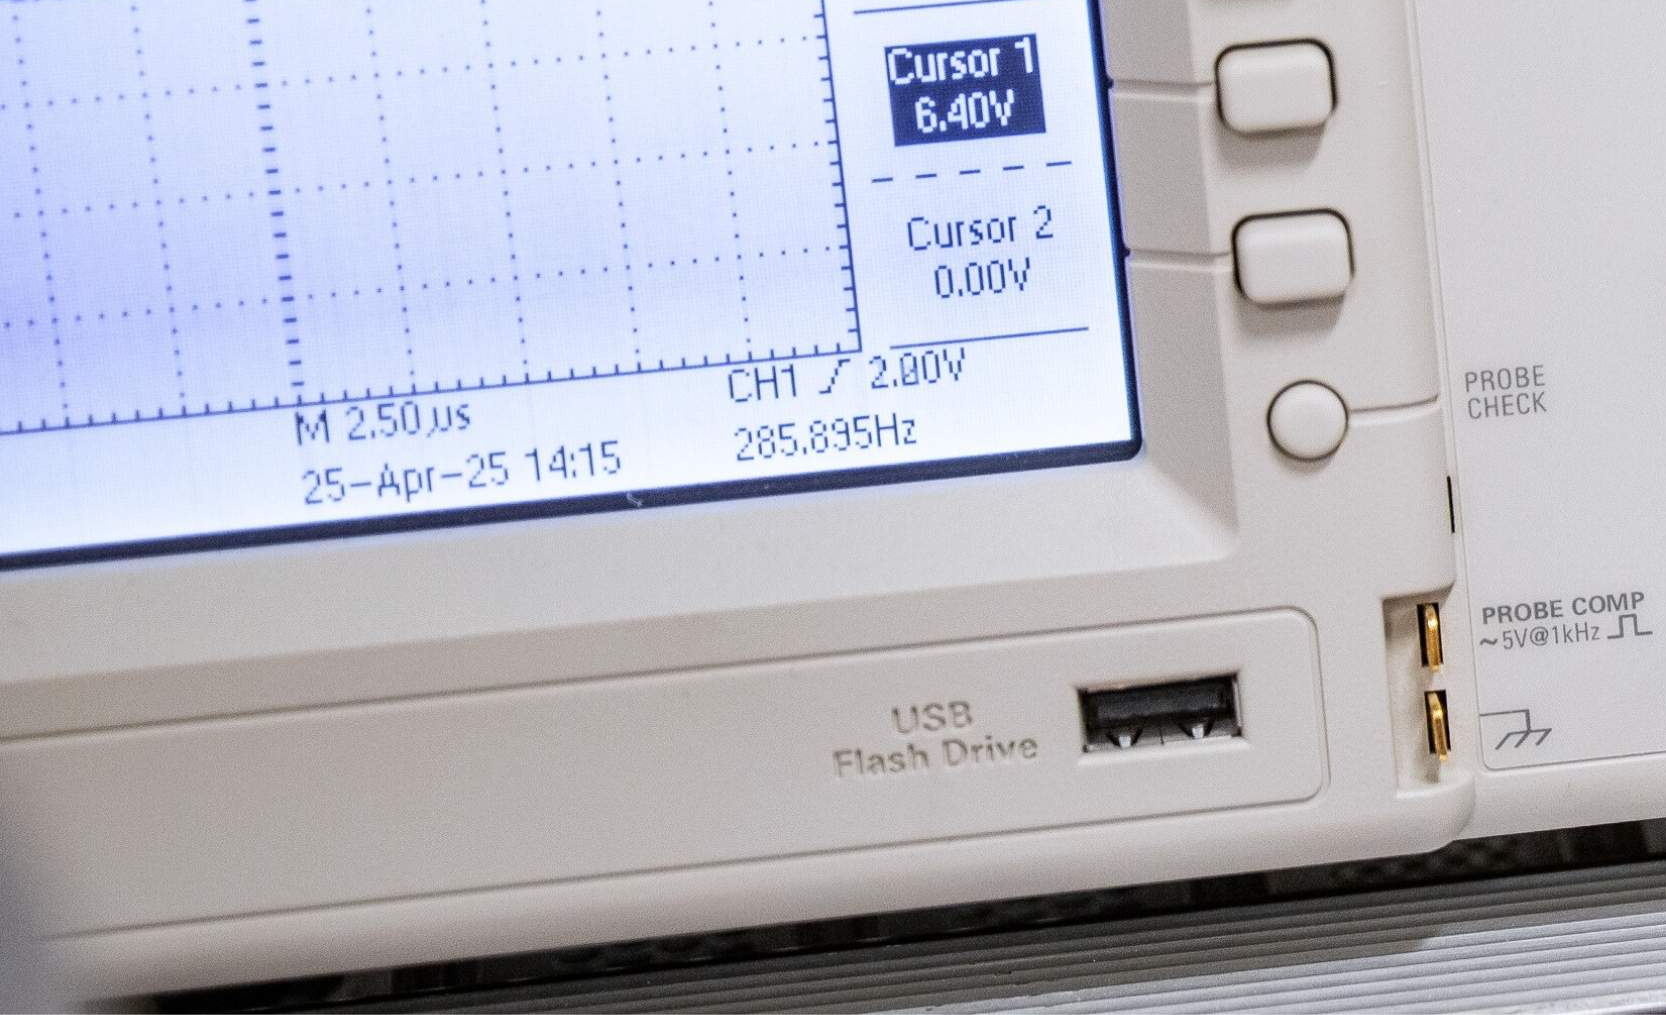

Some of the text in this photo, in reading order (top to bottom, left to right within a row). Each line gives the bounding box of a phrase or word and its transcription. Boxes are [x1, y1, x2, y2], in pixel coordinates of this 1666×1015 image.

[888, 35, 1037, 86] Cursor 1
[914, 88, 1017, 134] 6.40V
[907, 203, 1056, 252] Cursor 2
[934, 257, 1032, 300] 0.00V
[727, 366, 799, 404] CH1
[1465, 365, 1546, 395] PROBE
[1466, 390, 1548, 421] CHECK
[295, 411, 331, 447] M
[735, 414, 919, 463] 285.895Hz
[303, 439, 623, 508] 25-Apr-25 14:15
[1481, 591, 1646, 625] PROBE COMP
[892, 700, 974, 736] USB
[834, 734, 1038, 779] Flash Drive
